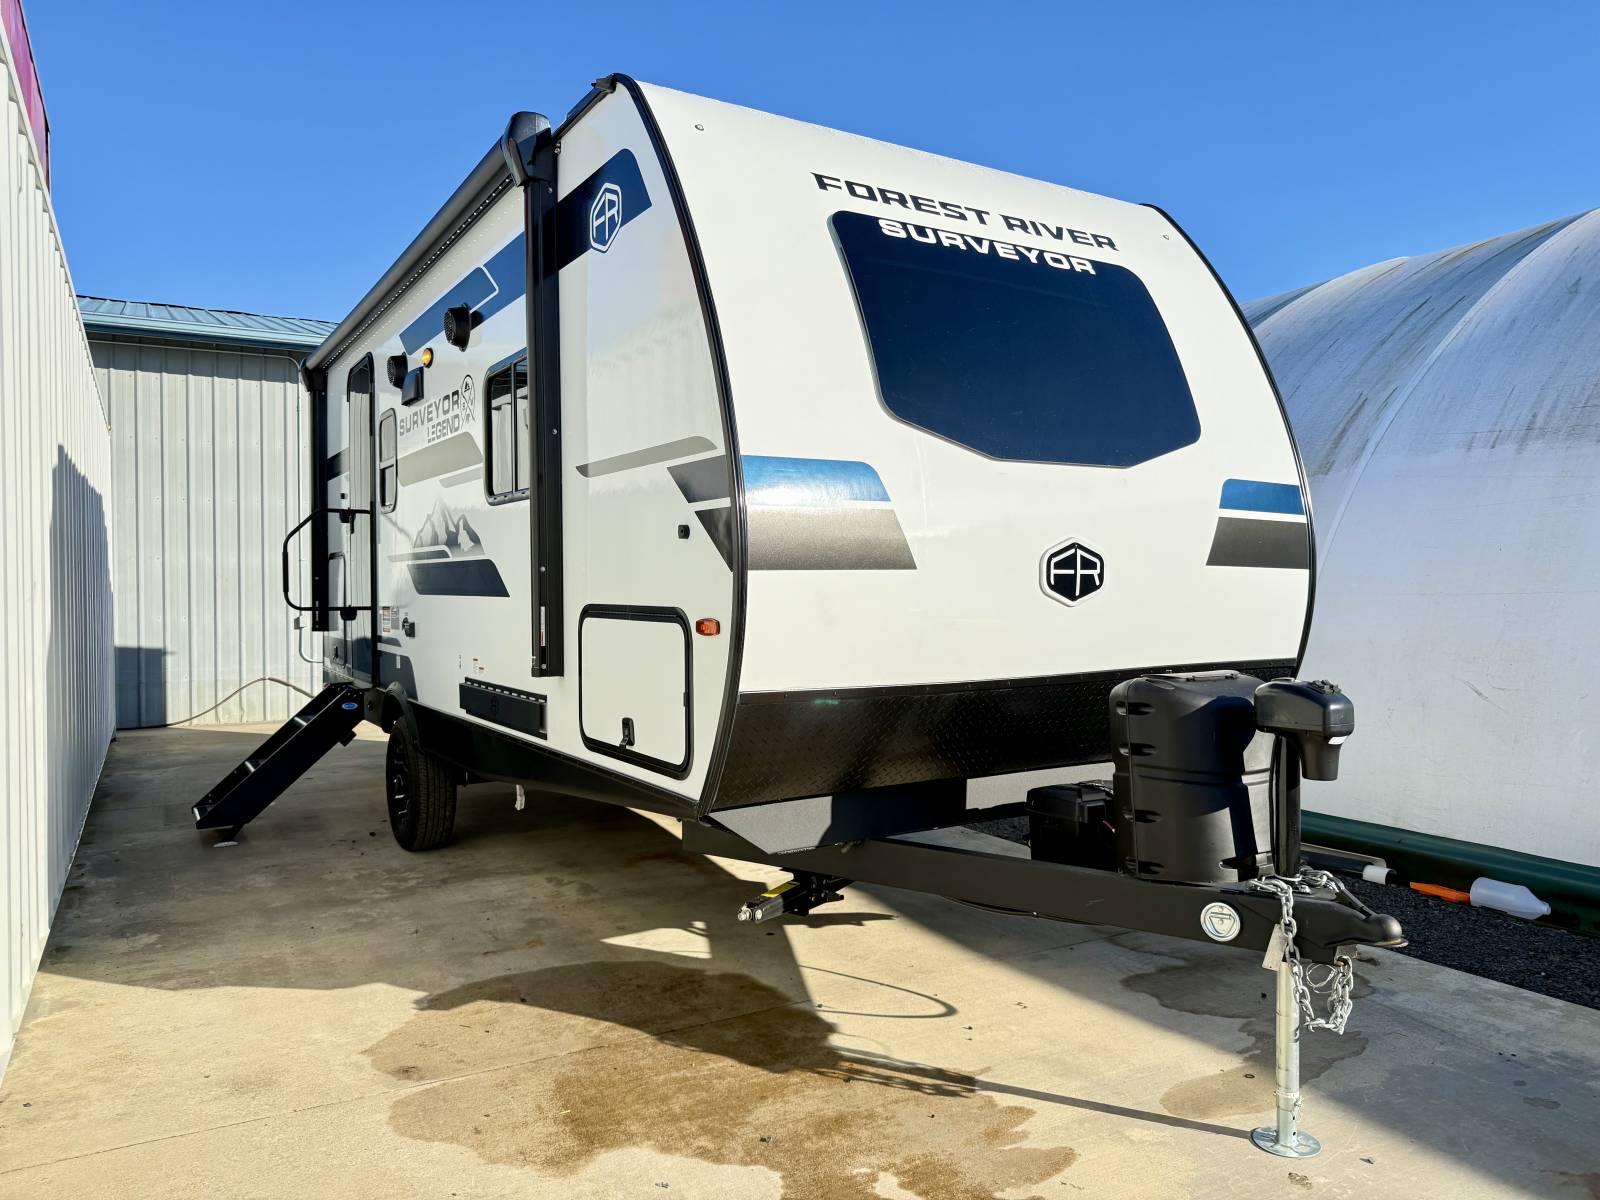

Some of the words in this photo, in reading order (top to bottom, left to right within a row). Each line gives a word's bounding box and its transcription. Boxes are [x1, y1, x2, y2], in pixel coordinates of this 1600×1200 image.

[810, 172, 990, 225] FOREST
[998, 213, 1120, 251] RIVER
[878, 218, 1096, 275] SURVEYOR
[399, 389, 460, 437] SURVEYOR
[427, 413, 460, 444] LEGEND
